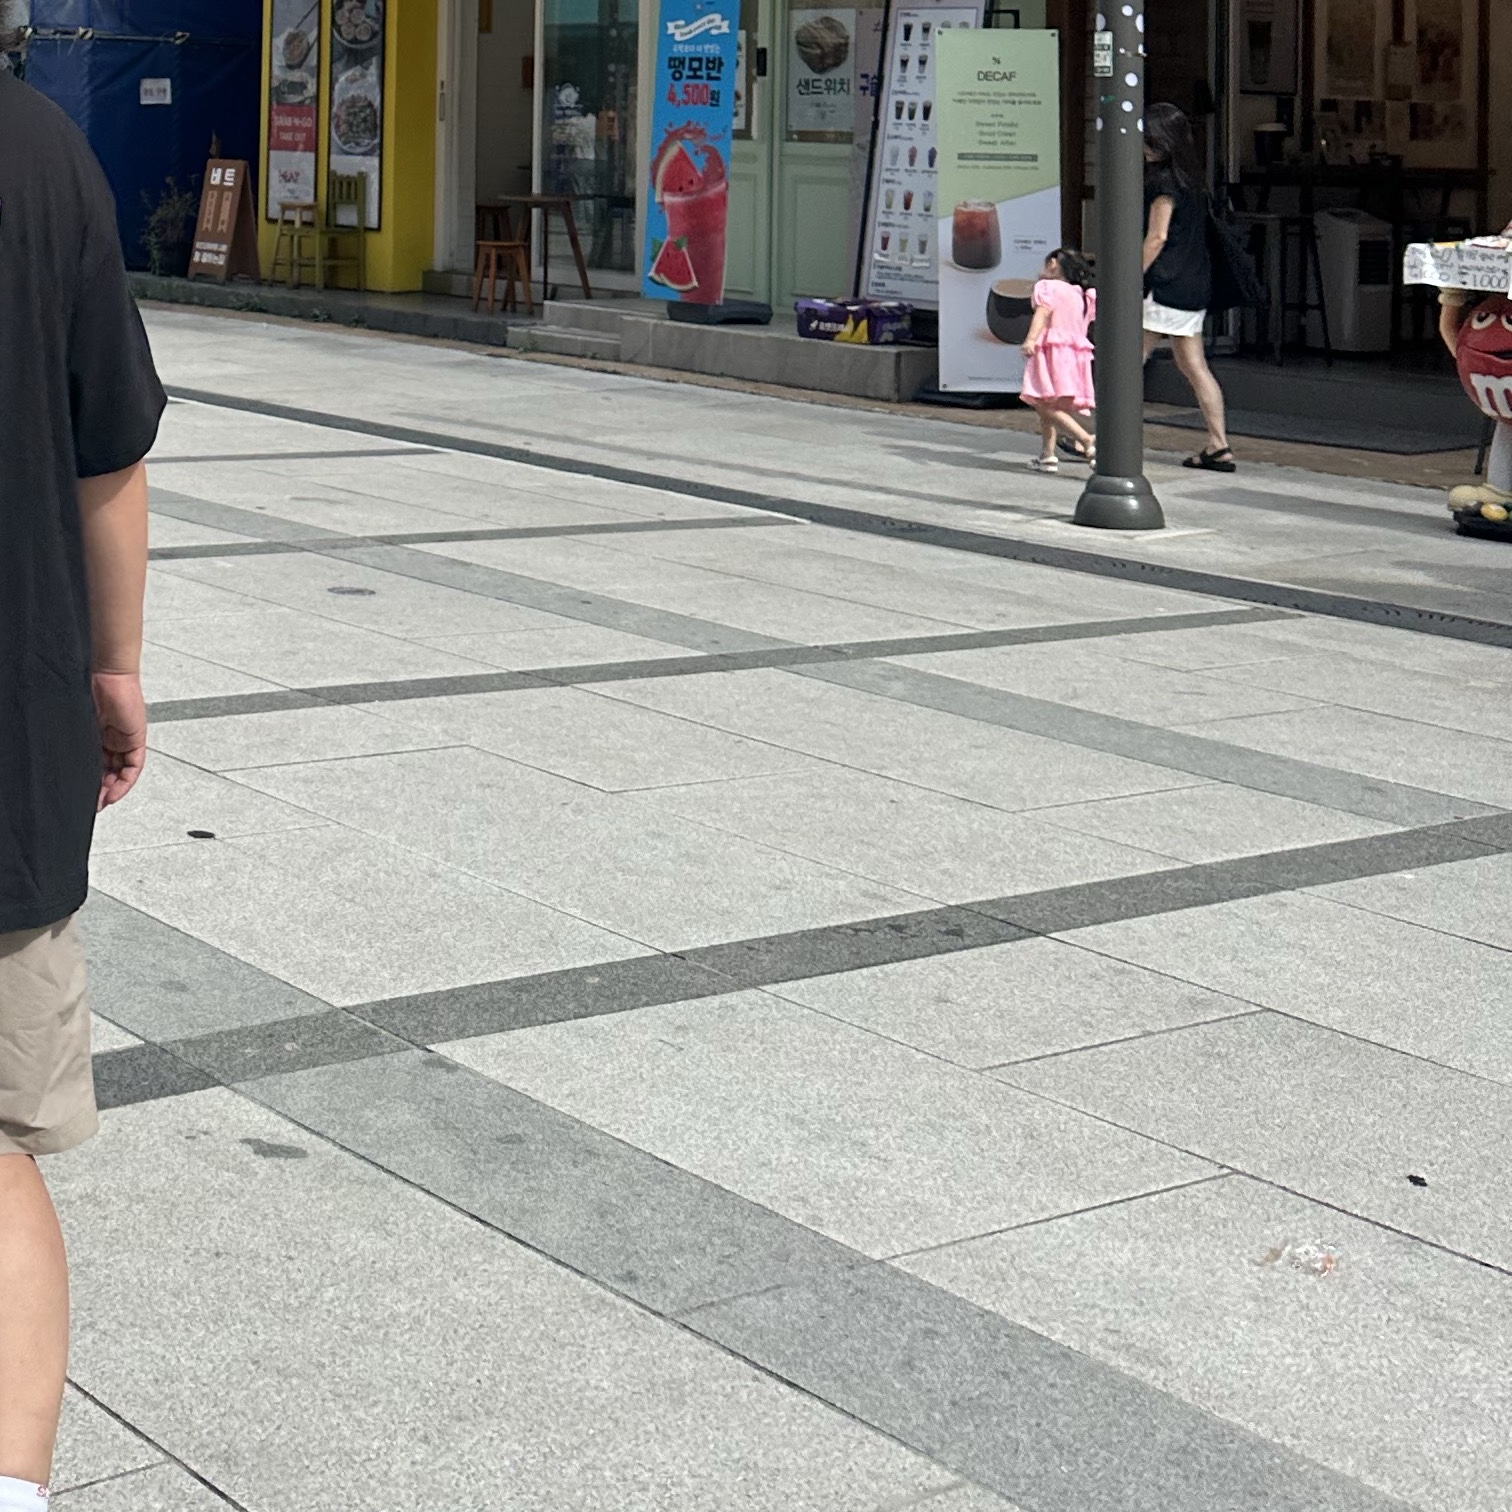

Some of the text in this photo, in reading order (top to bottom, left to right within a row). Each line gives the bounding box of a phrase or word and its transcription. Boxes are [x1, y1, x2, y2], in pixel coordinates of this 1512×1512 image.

[667, 55, 724, 82] 땡모반
[977, 70, 1017, 82] DECAF
[796, 76, 851, 97] 샌드위치
